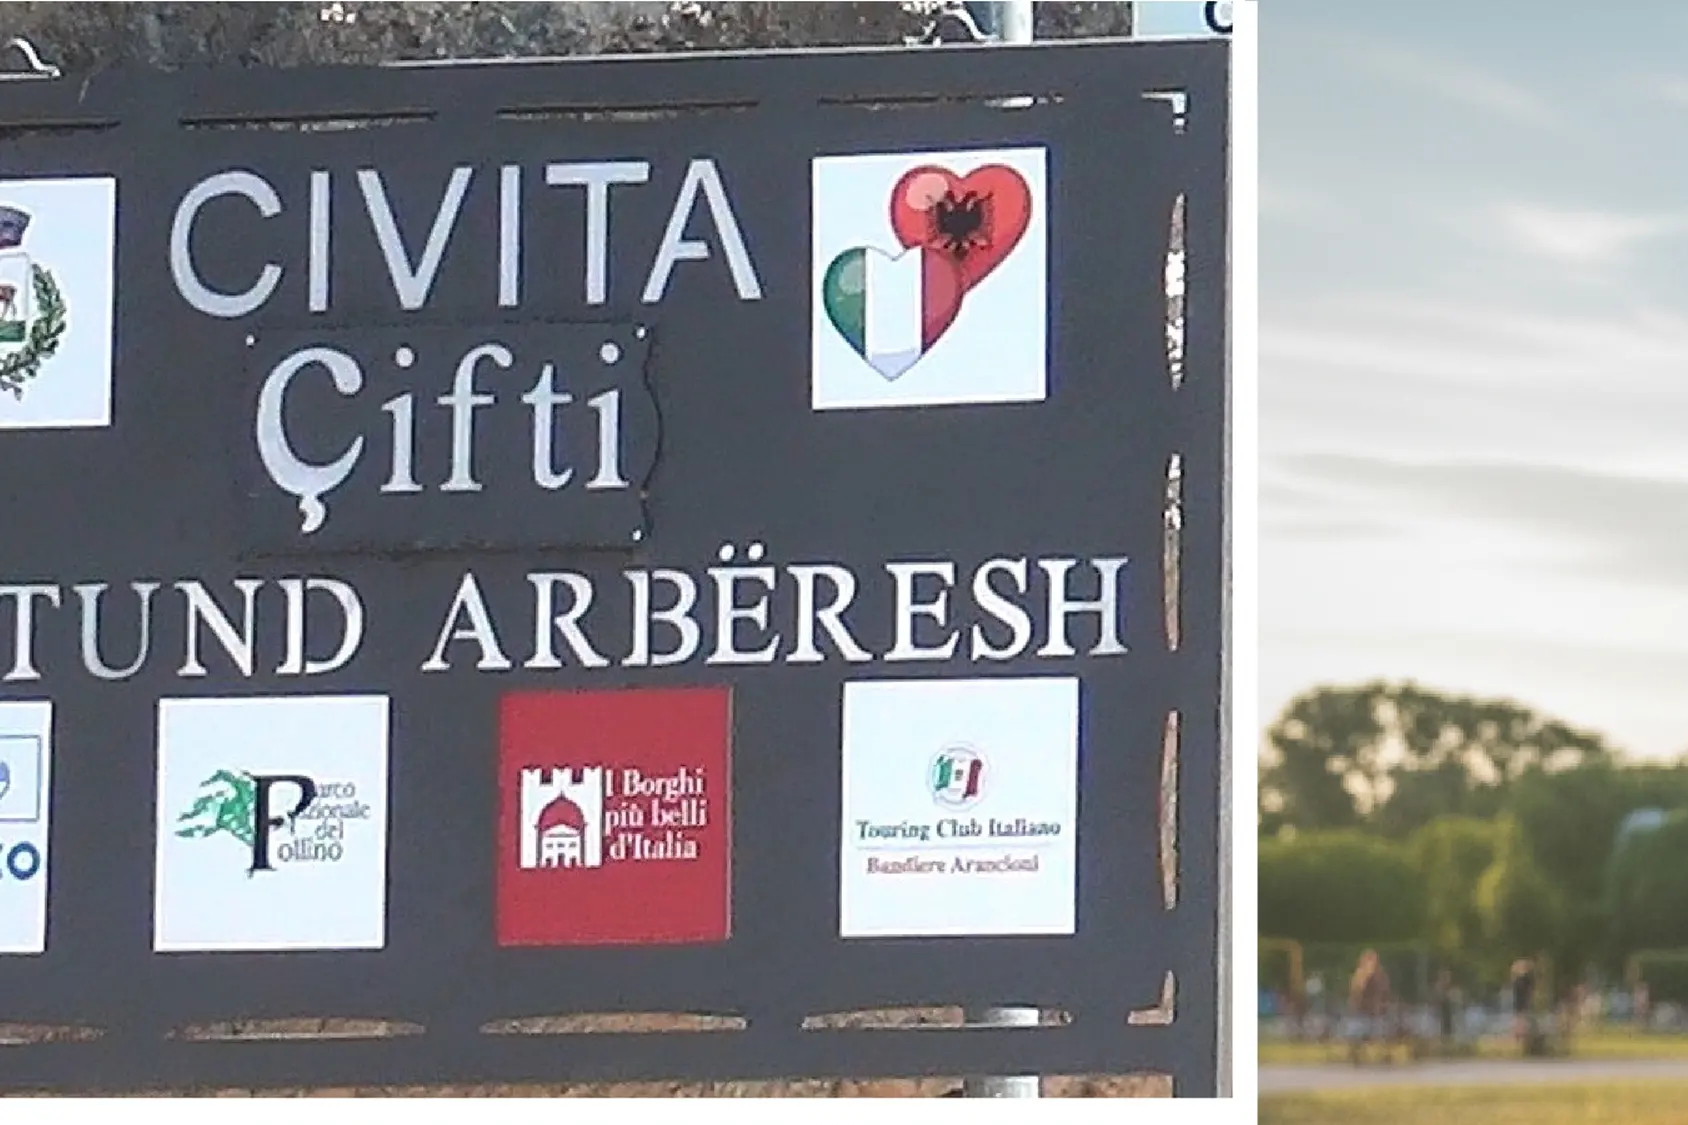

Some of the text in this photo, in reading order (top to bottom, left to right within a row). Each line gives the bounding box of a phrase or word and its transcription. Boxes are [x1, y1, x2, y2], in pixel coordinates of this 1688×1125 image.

[169, 158, 764, 317] CIVITA
[256, 343, 631, 533] Çifti
[0, 543, 1129, 681] TUND ARBËRESH
[623, 766, 704, 803] Borghi
[651, 798, 707, 827] belli
[855, 817, 1062, 842] Touring Club Italiano
[609, 830, 697, 860] d'Italia
